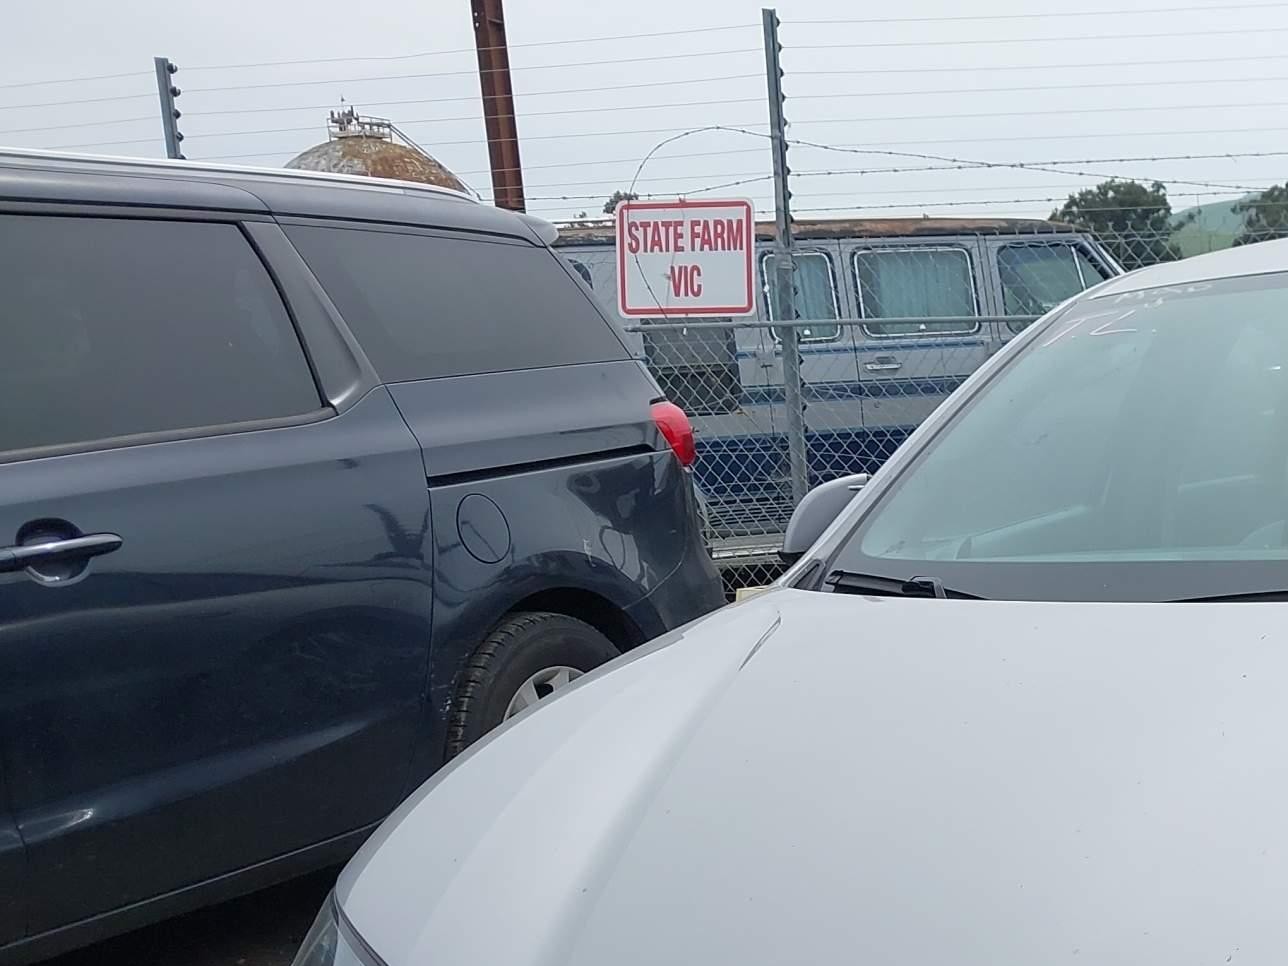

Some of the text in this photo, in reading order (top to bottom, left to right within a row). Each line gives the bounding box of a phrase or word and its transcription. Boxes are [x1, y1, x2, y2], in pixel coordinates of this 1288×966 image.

[628, 218, 744, 254] STATE FARM
[669, 264, 702, 298] VIC
